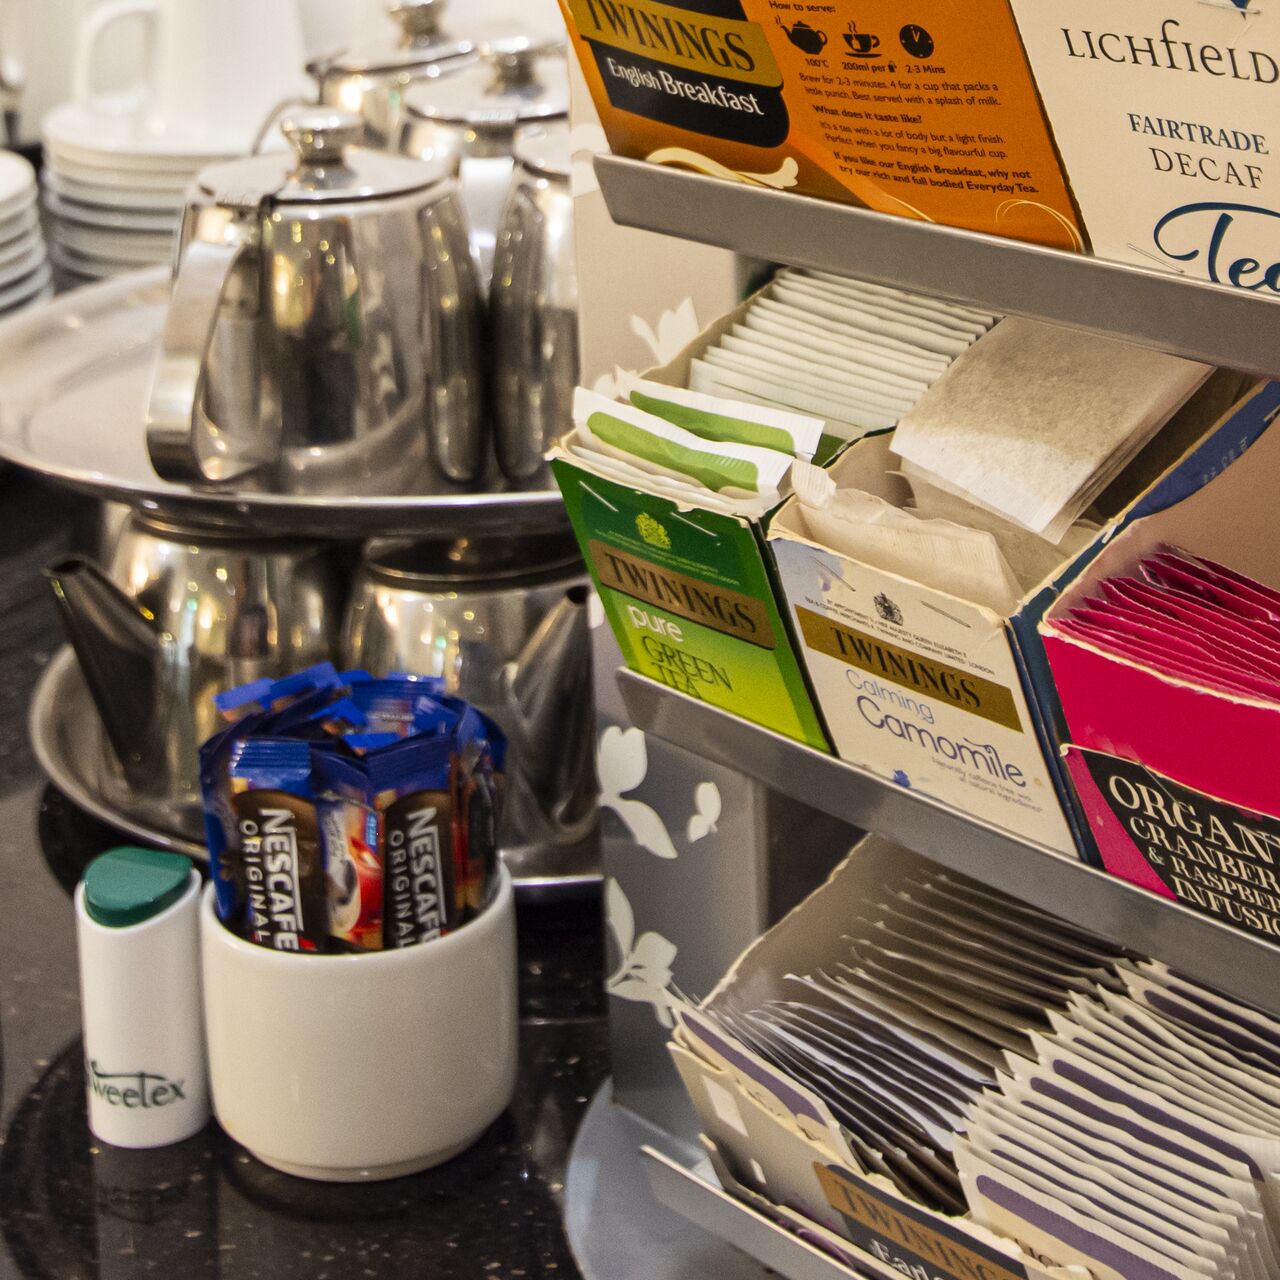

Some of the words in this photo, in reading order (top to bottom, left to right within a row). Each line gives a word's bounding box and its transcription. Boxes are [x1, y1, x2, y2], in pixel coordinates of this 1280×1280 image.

[768, 0, 790, 10] How
[793, 3, 804, 11] to
[799, 72, 821, 83] Brew
[822, 76, 834, 85] for
[898, 81, 912, 90] for
[923, 84, 939, 93] cup
[942, 82, 961, 91] that
[963, 82, 991, 93] packs
[842, 62, 869, 71] 200ml
[871, 65, 885, 73] per
[922, 65, 946, 74] Mins
[606, 56, 662, 92] English
[662, 66, 765, 118] Breakfast
[851, 91, 871, 101] Best
[873, 93, 903, 103] served
[905, 96, 926, 104] with
[935, 96, 963, 107] splash
[966, 95, 976, 105] of
[812, 104, 840, 116] What
[841, 110, 863, 119] does
[864, 111, 872, 120] it
[874, 113, 899, 122] taste
[900, 113, 922, 124] like?
[856, 139, 878, 148] when
[880, 143, 895, 151] you
[896, 143, 918, 155] fancy
[928, 146, 943, 158] big
[943, 147, 985, 157] flavourful
[988, 151, 1008, 160] cup.
[881, 129, 893, 138] lot
[906, 131, 928, 142] body
[930, 132, 946, 141] but
[955, 134, 976, 145] light
[978, 134, 1006, 144] finish.
[1126, 112, 1270, 156] FAIRTRADE
[843, 155, 859, 163] you
[859, 156, 876, 166] like
[896, 161, 932, 174] English
[933, 165, 986, 178] Breakfast,
[987, 169, 1009, 180] why
[1012, 170, 1032, 179] not
[855, 169, 870, 177] our
[873, 170, 891, 180] rich
[893, 174, 910, 183] and
[911, 175, 928, 186] full
[930, 178, 964, 189] bodied
[966, 181, 1015, 194] Everyday
[1014, 183, 1039, 193] Tea.
[1151, 148, 1265, 191] DECAF
[604, 552, 759, 635] TWININGS
[626, 605, 683, 642] pure
[641, 635, 734, 692] GREEN
[650, 660, 704, 699] TEA
[829, 624, 982, 710] TWININGS
[844, 668, 935, 725] Calming
[856, 694, 1028, 790] Camomile
[1146, 846, 1166, 866] &
[240, 819, 271, 942] ORIGINAL
[90, 1060, 186, 1109] weetex
